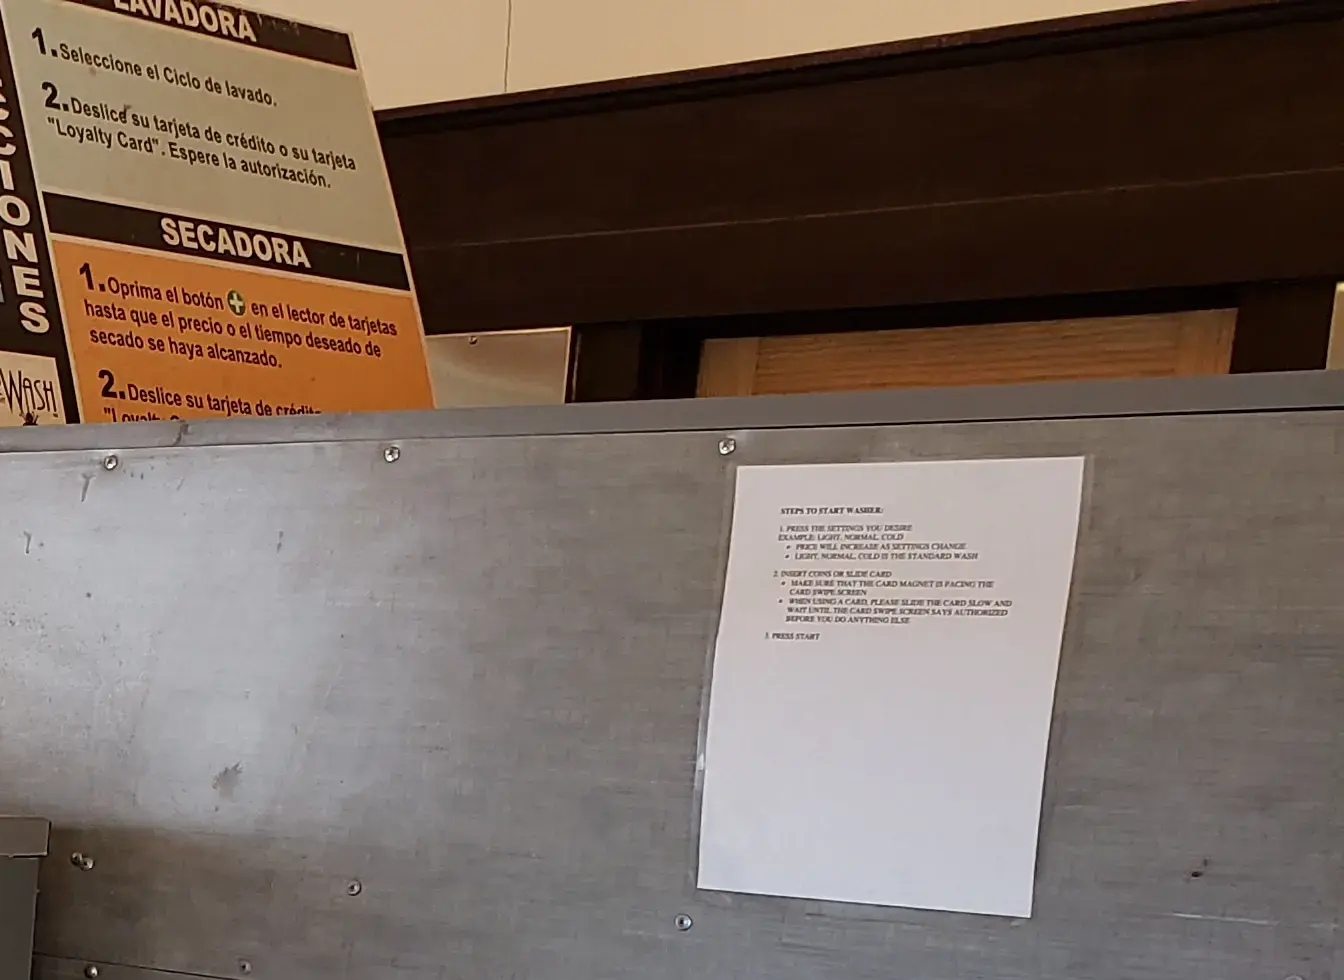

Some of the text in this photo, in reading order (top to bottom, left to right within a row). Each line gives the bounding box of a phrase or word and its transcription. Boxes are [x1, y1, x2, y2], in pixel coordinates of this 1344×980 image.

[31, 27, 277, 107] 1. Seleccione el Ciclo de lavado.
[41, 82, 356, 171] 2. Deslice su tarjeta de crédito o su tarjeta
[47, 117, 112, 149] "Loyalty
[169, 142, 219, 169] Espere
[223, 152, 237, 170] la
[240, 158, 332, 189] autorización.
[161, 217, 312, 268] SECADORA
[79, 262, 398, 336] 1. Oprima el botón en el lector de tarjetas
[84, 299, 381, 357] hasta que el precio o el tiempo deseado de
[90, 328, 283, 368] secado se haya alcanzado.
[98, 369, 126, 400] 2.
[127, 383, 182, 406] Deslice
[186, 394, 204, 408] su
[207, 395, 252, 417] tarjeta
[256, 399, 273, 416] de
